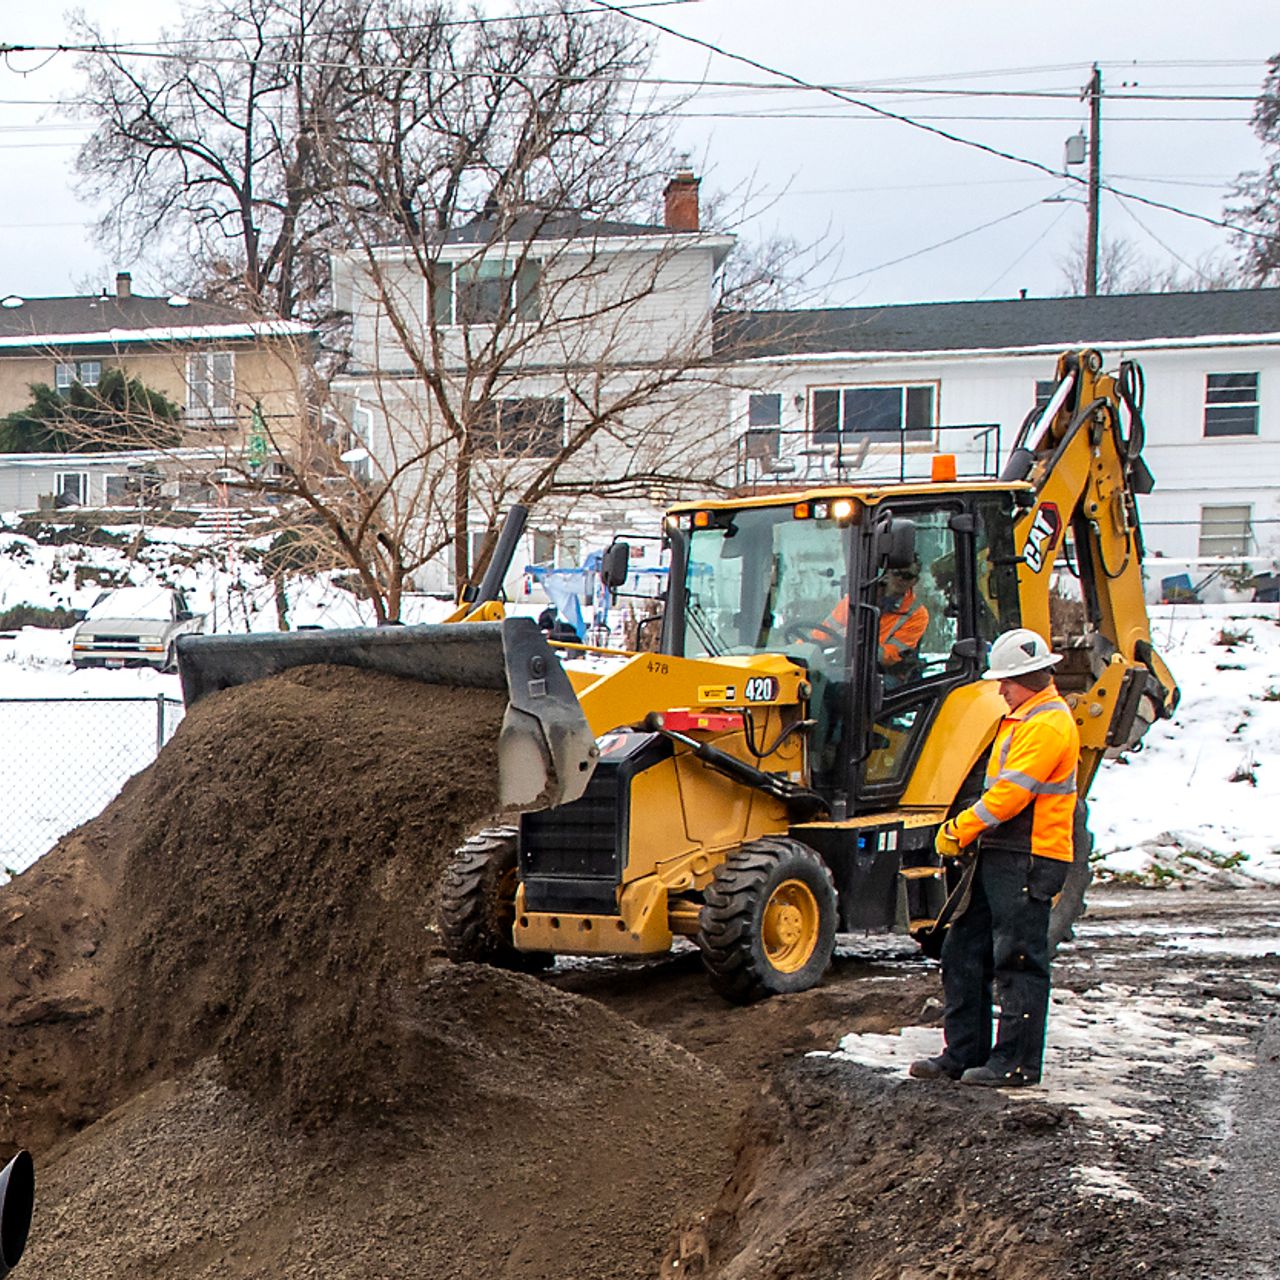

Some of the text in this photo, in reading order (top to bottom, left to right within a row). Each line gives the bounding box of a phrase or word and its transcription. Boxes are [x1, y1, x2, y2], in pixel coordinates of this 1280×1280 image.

[1023, 509, 1055, 573] CAT
[646, 660, 669, 675] 478
[745, 677, 772, 701] 420
